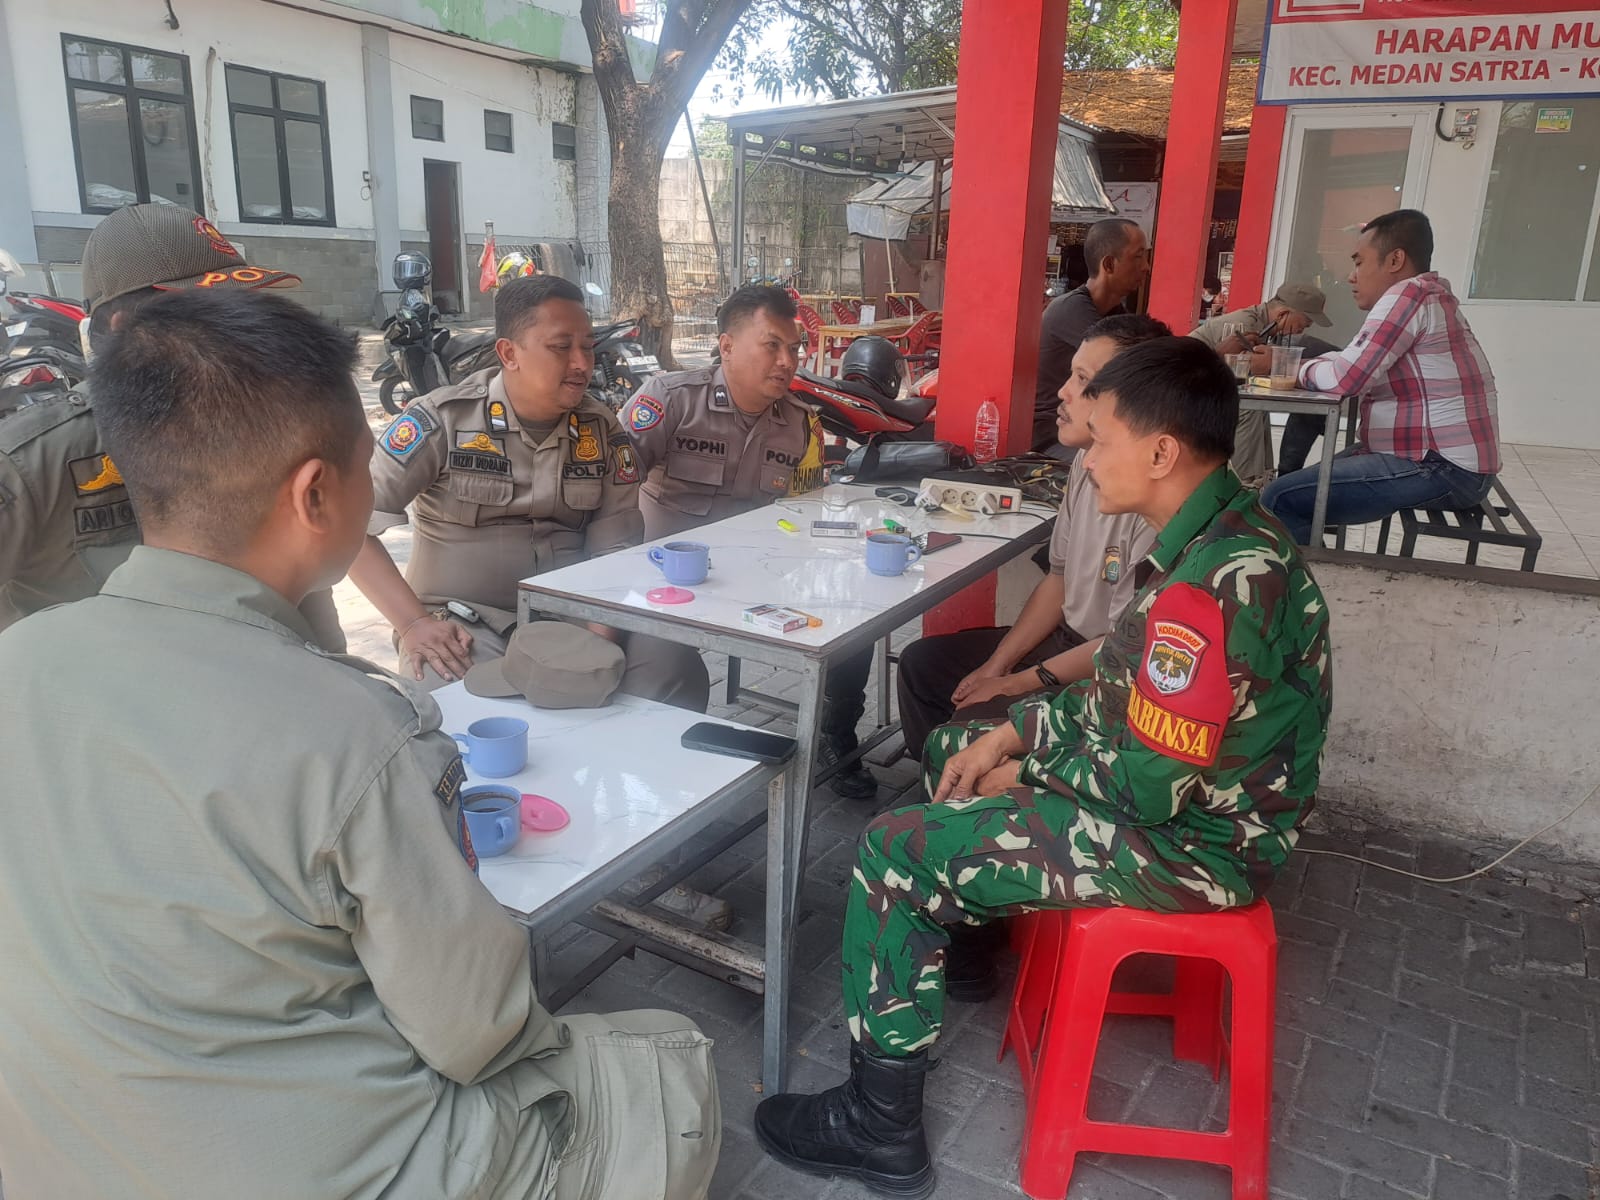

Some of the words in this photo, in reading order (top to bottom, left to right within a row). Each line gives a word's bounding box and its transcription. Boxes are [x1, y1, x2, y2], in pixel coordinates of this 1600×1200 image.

[1375, 24, 1541, 55] HARAPAN
[1288, 65, 1341, 87] KEC.
[1350, 62, 1443, 85] MEDAN
[1449, 59, 1550, 83] SATRIA
[1579, 57, 1600, 79] K
[675, 436, 725, 455] YOPHI
[564, 465, 595, 477] POL
[1158, 625, 1184, 639] KODIM
